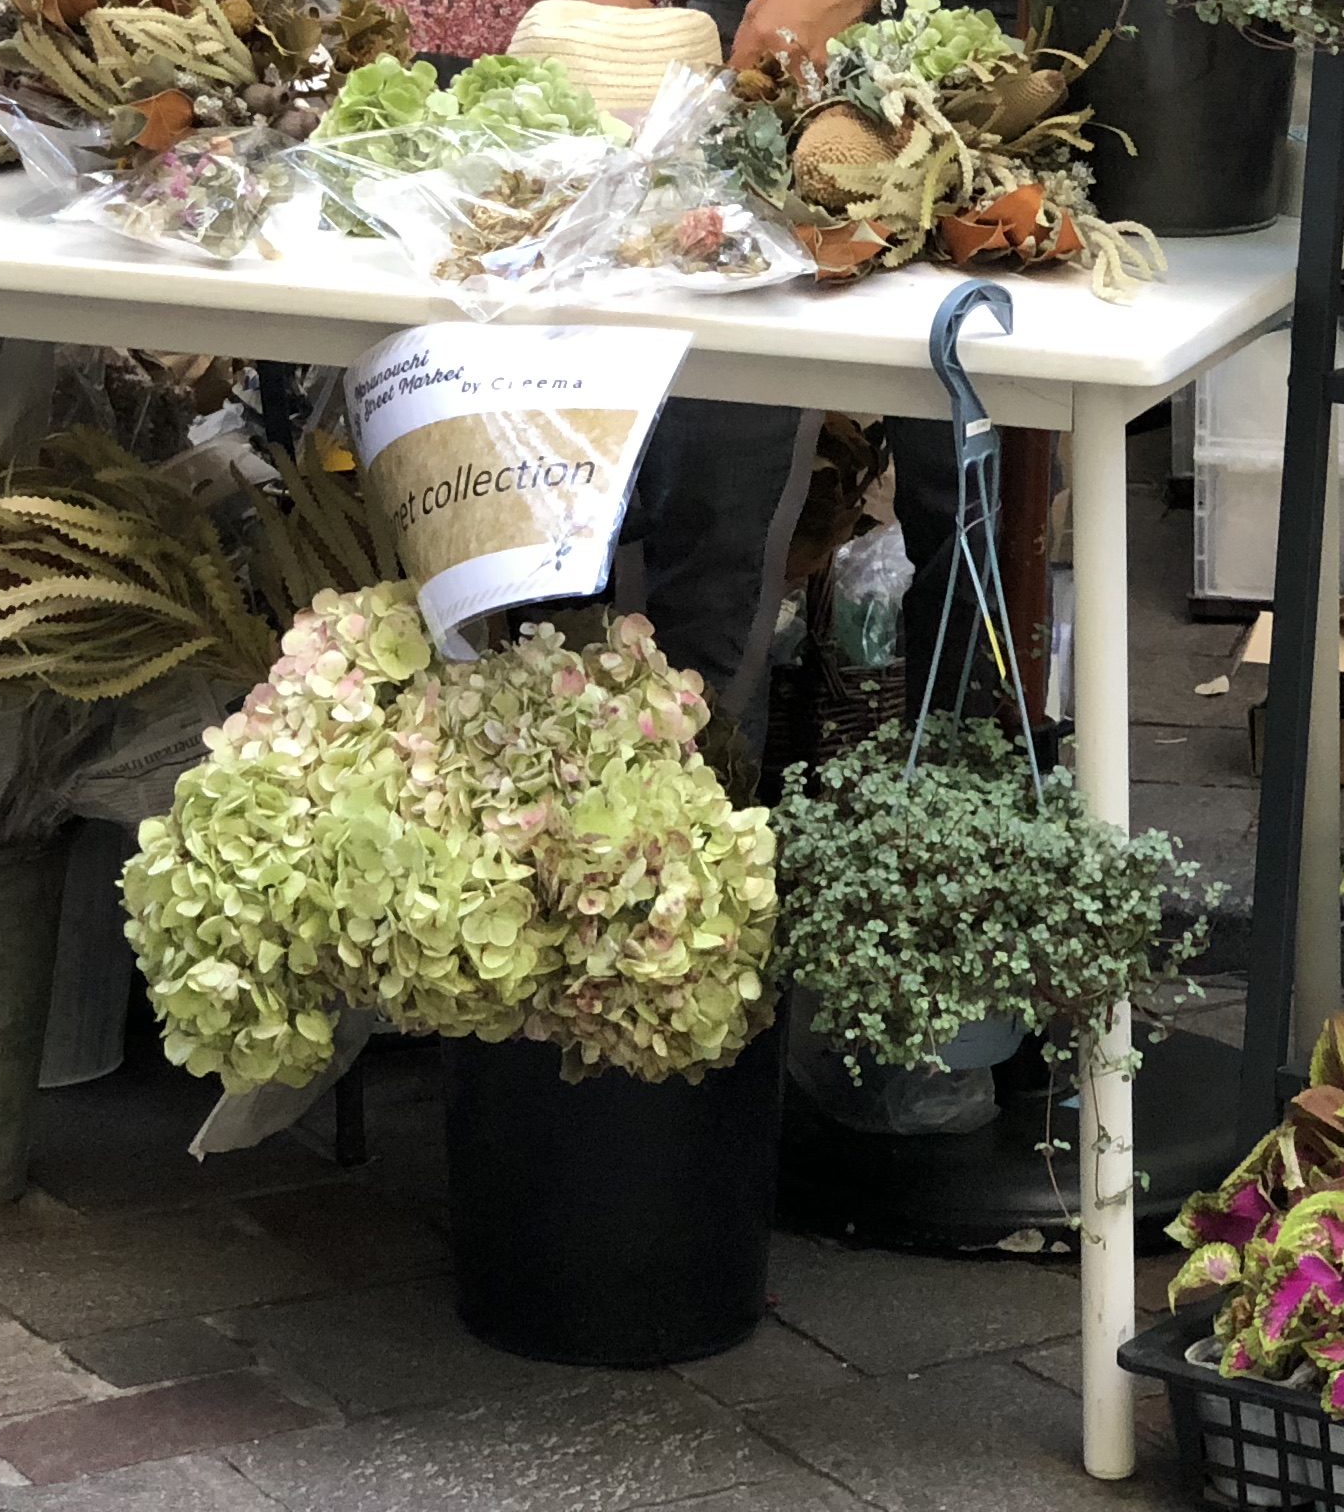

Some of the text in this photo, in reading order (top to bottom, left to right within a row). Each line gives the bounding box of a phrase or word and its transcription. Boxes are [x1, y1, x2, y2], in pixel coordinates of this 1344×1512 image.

[398, 366, 465, 396] Market
[461, 380, 482, 395] by
[421, 455, 597, 516] collection
